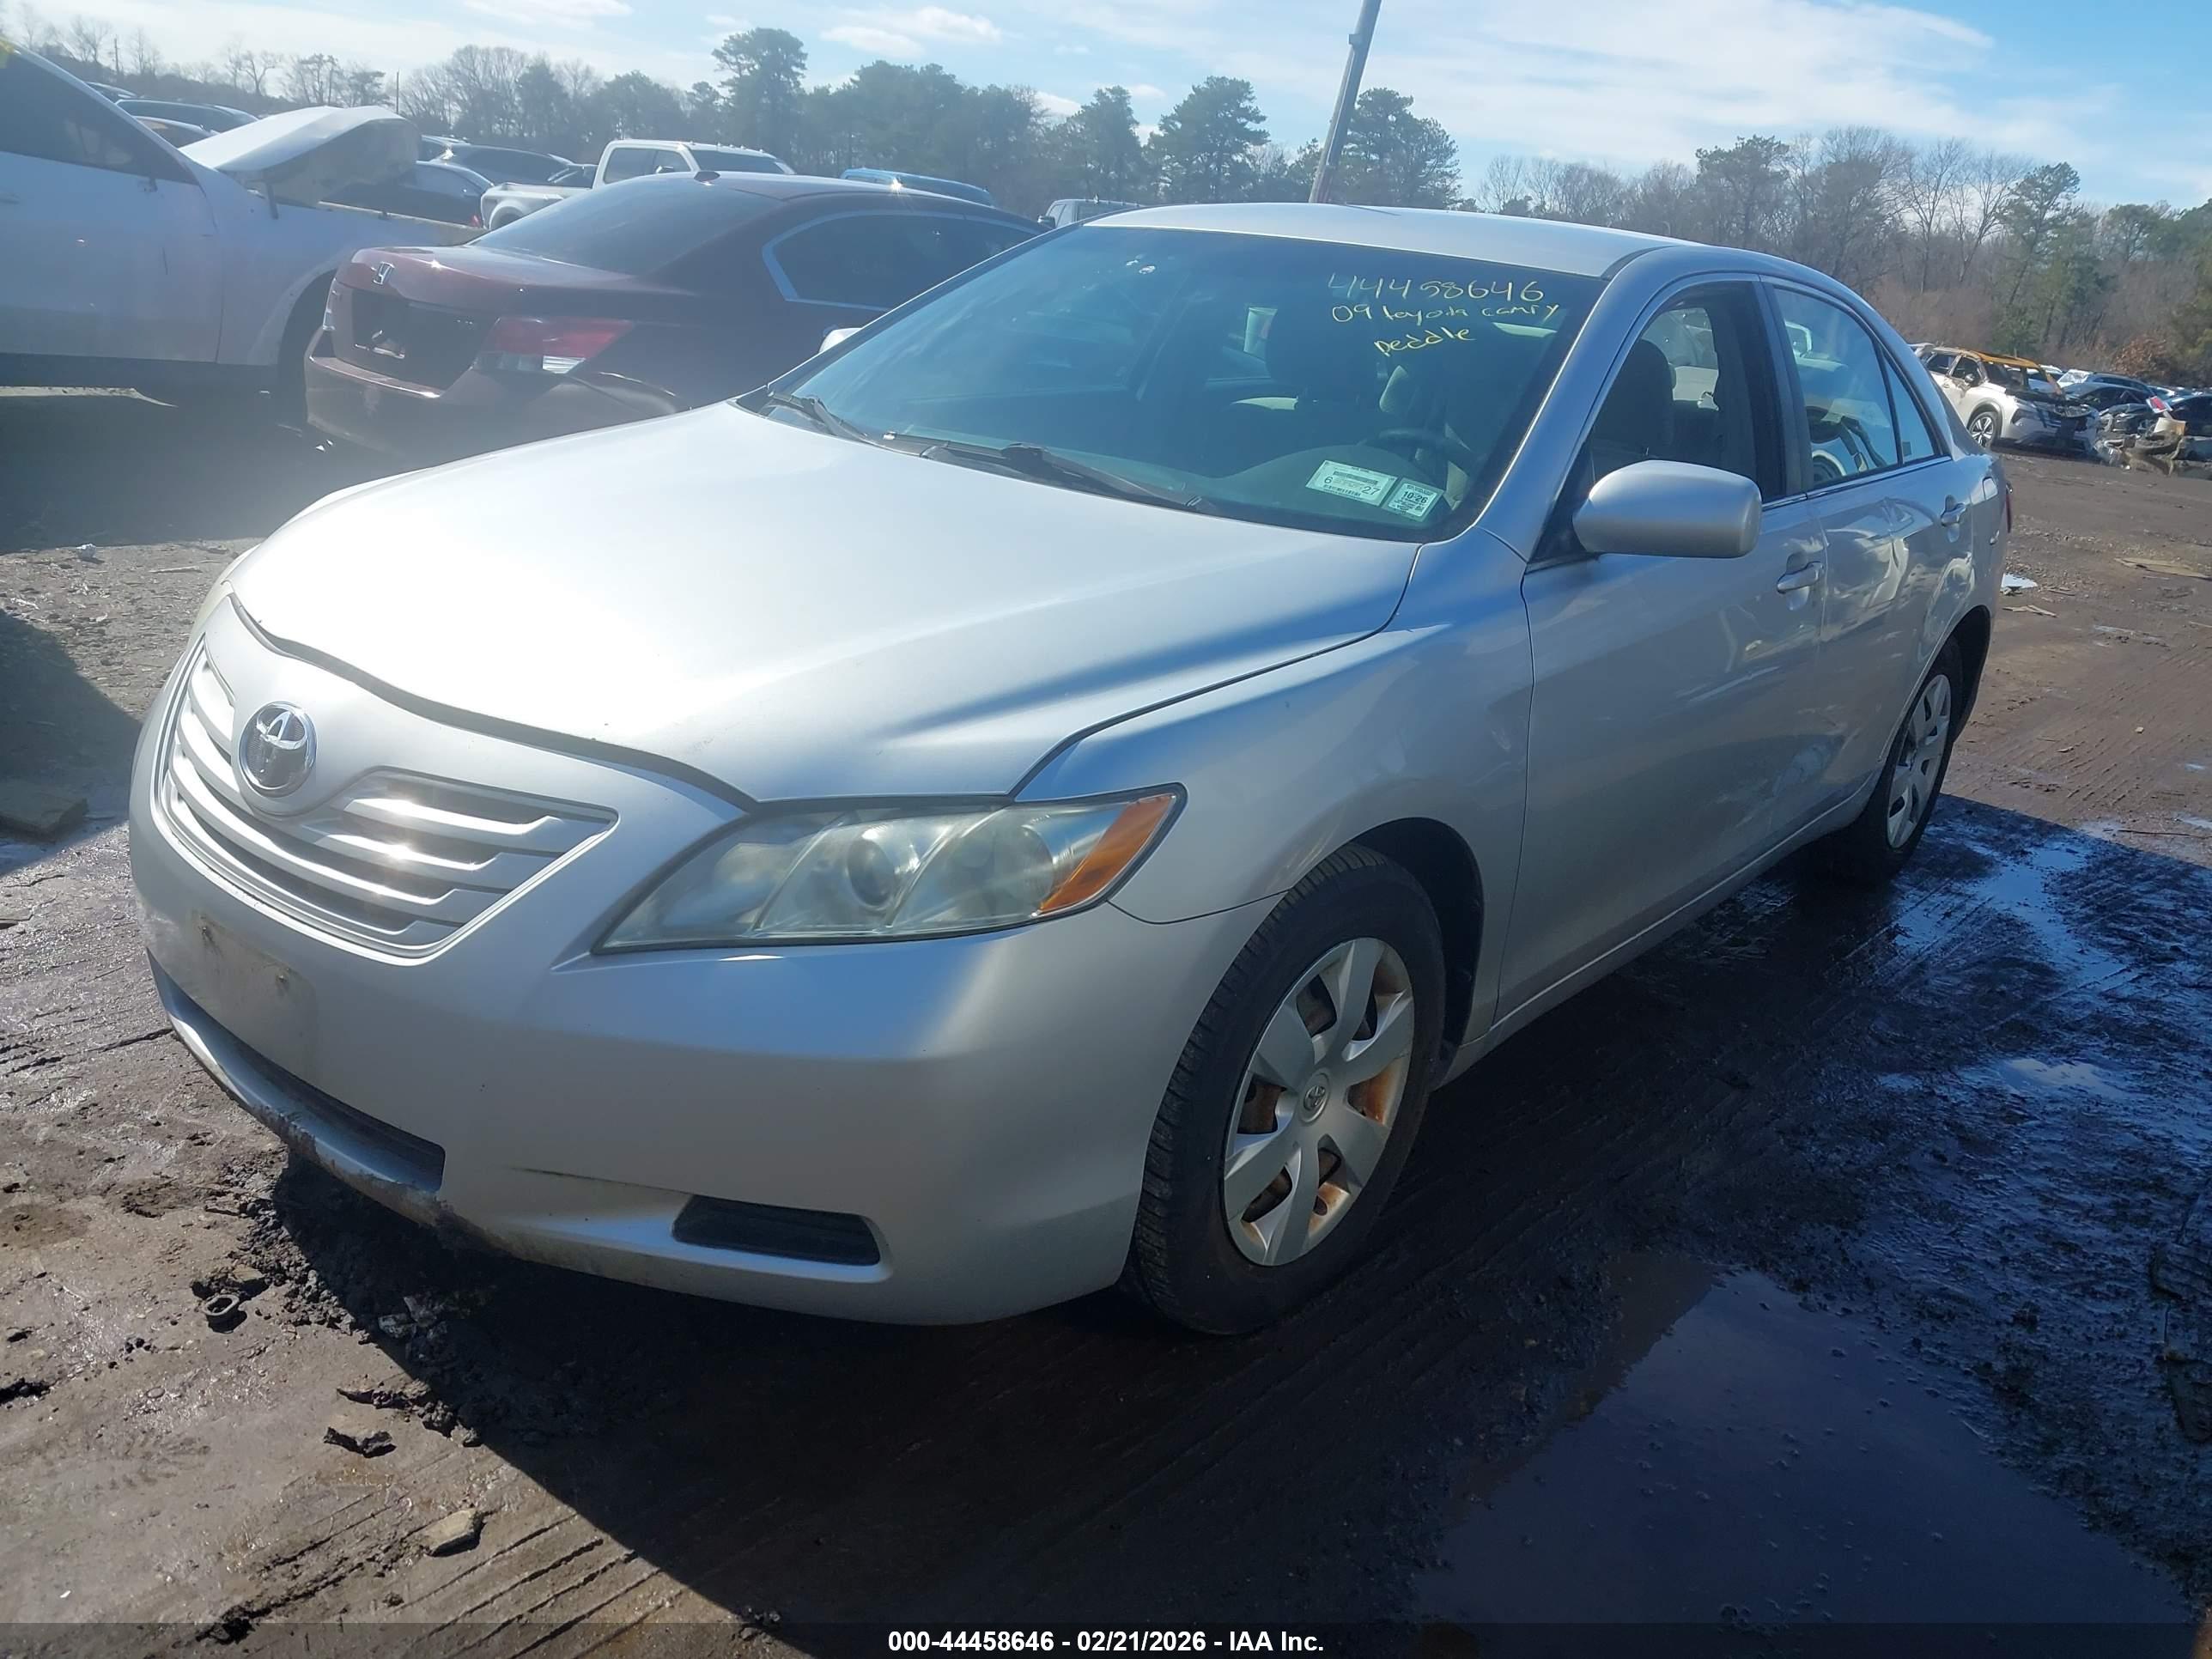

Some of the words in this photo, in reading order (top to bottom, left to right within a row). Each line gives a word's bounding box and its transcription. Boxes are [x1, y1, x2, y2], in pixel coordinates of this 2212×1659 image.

[1328, 272, 1544, 301] 44458646
[1332, 304, 1371, 322] 09
[1324, 476, 1334, 484] 6
[1361, 485, 1381, 495] 27
[1403, 490, 1429, 504] 10-26
